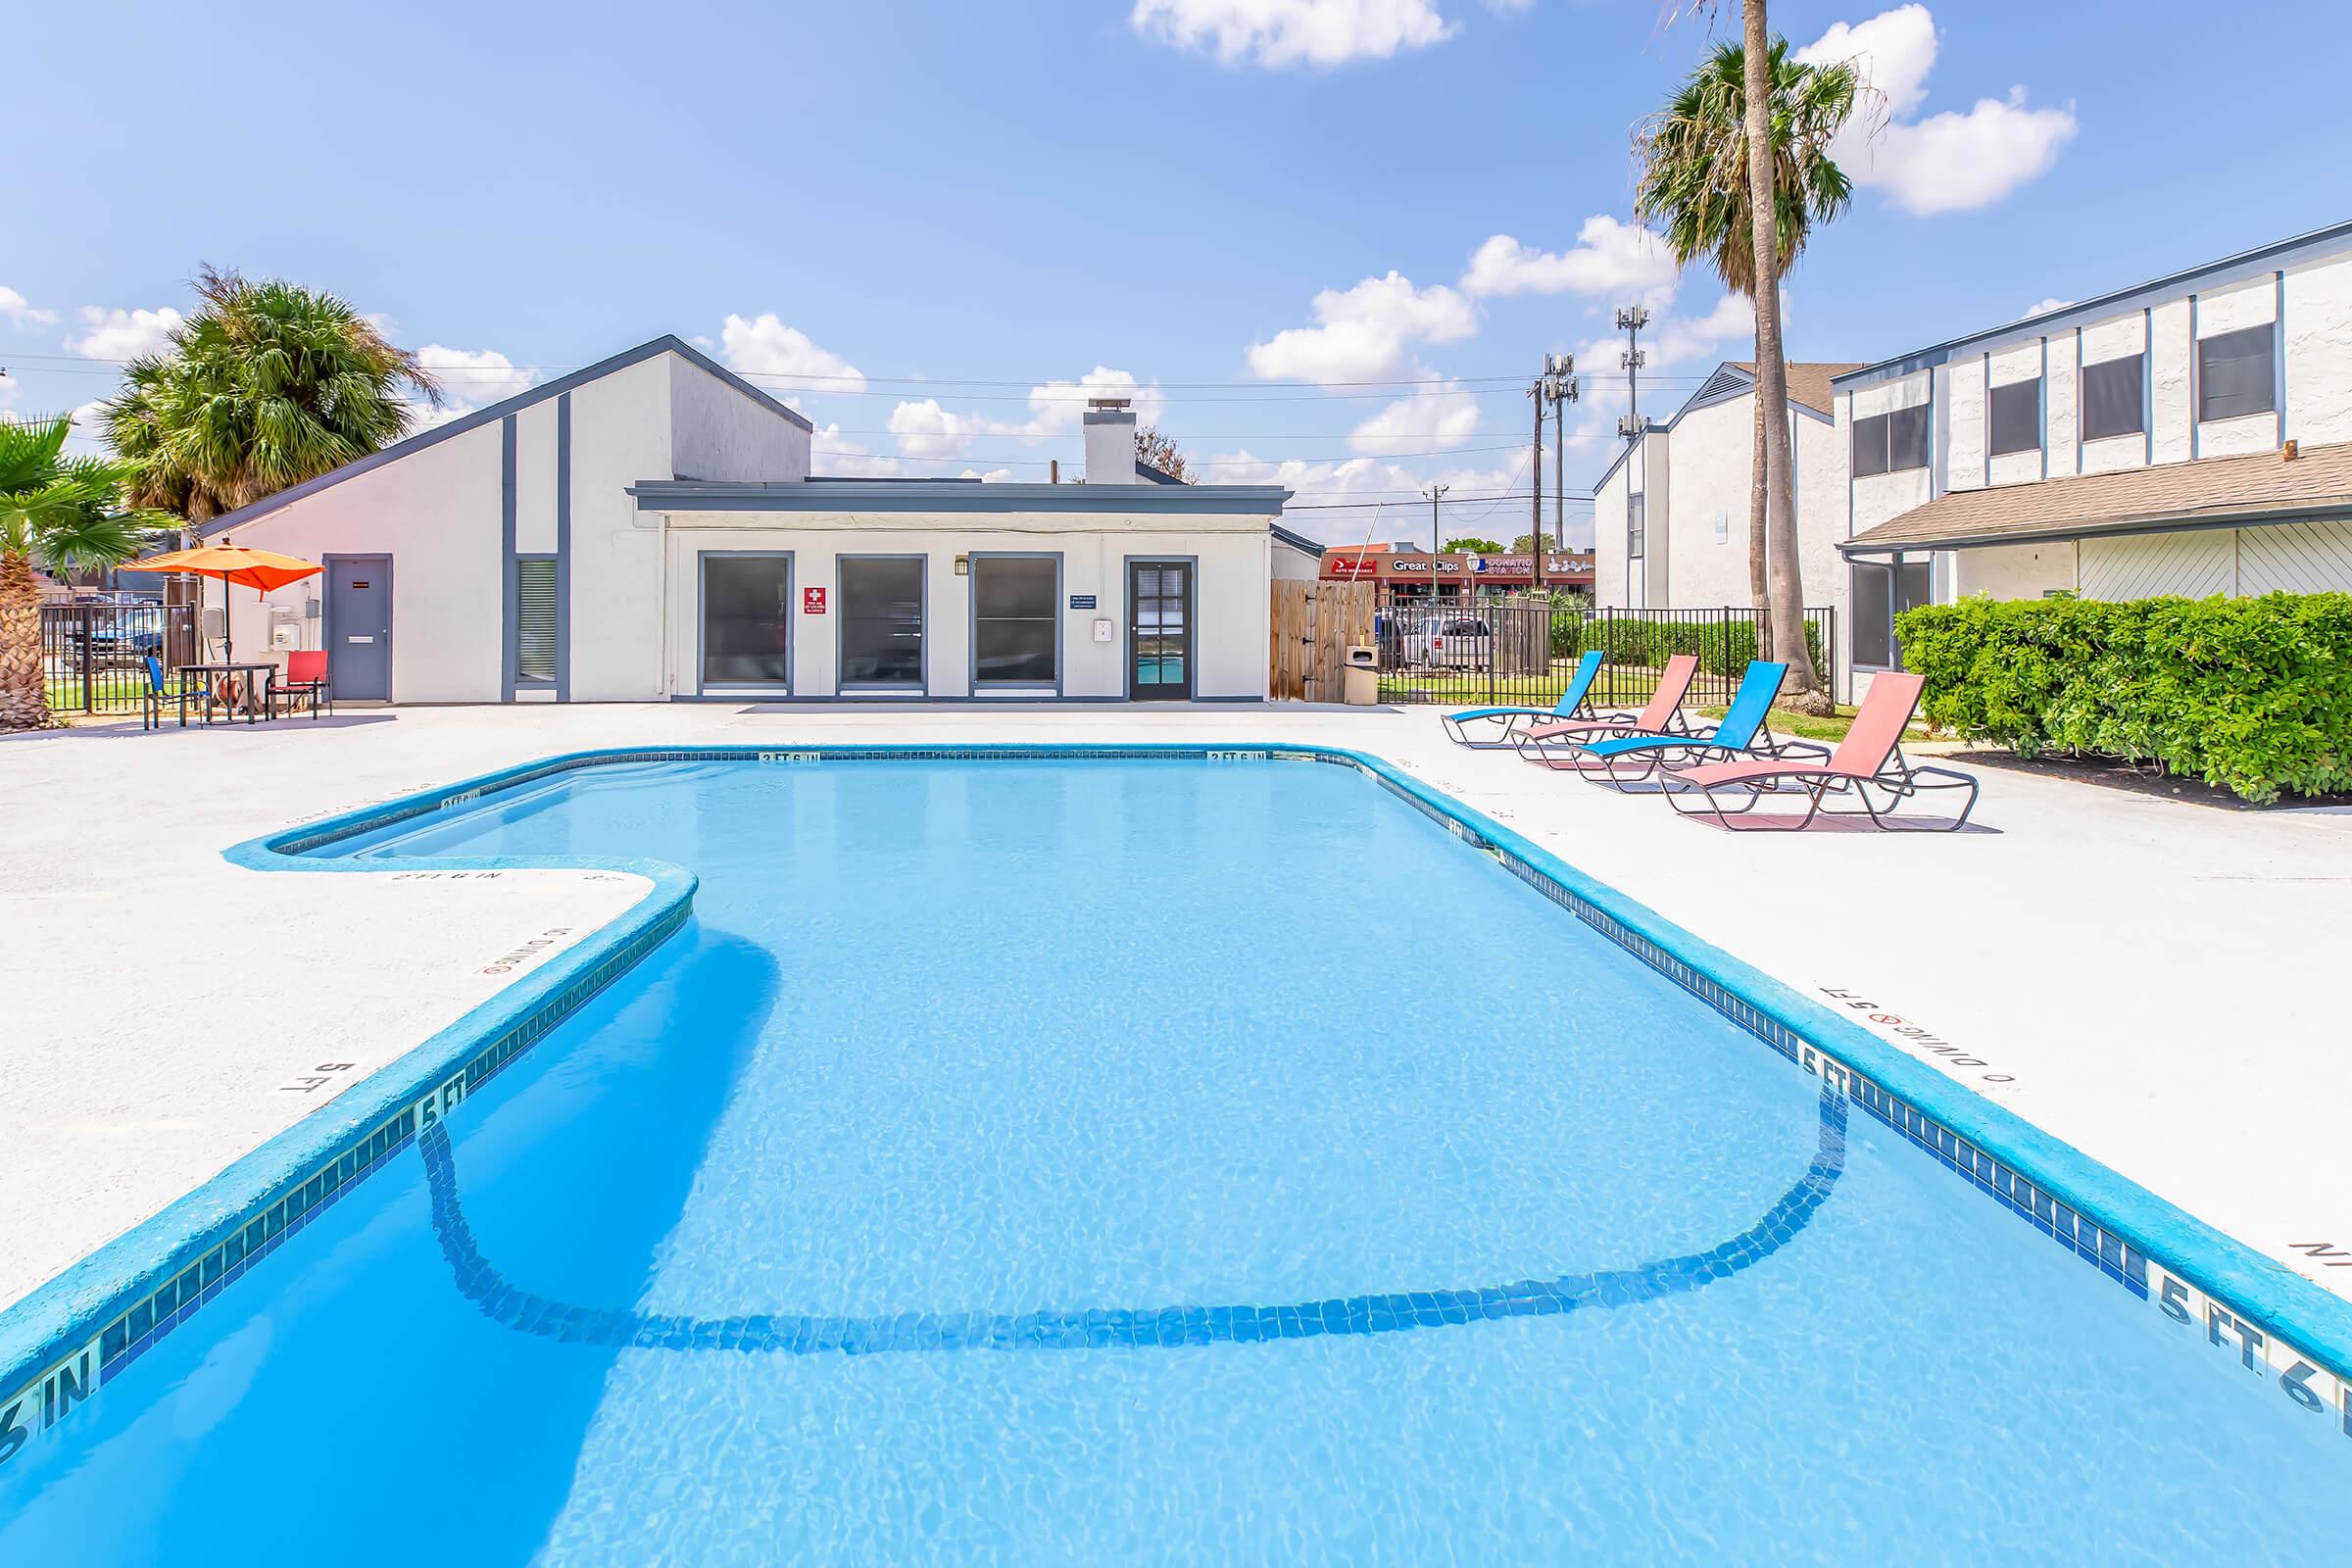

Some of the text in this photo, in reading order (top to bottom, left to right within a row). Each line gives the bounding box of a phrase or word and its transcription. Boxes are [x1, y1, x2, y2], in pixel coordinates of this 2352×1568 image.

[1394, 560, 1459, 572] Great Clips
[807, 753, 818, 761] IN
[1252, 752, 1265, 760] IN
[1819, 987, 1862, 999] FT
[1845, 1002, 1880, 1010] 5
[1892, 1026, 1989, 1066] DIVING
[279, 1062, 356, 1094] 5 FT
[1803, 1048, 1846, 1096] 5 FT
[422, 1095, 438, 1133] 5
[2287, 1243, 2352, 1267] IN
[2158, 1275, 2191, 1326] 5
[2278, 1360, 2325, 1414] 6
[0, 1398, 29, 1465] 6
